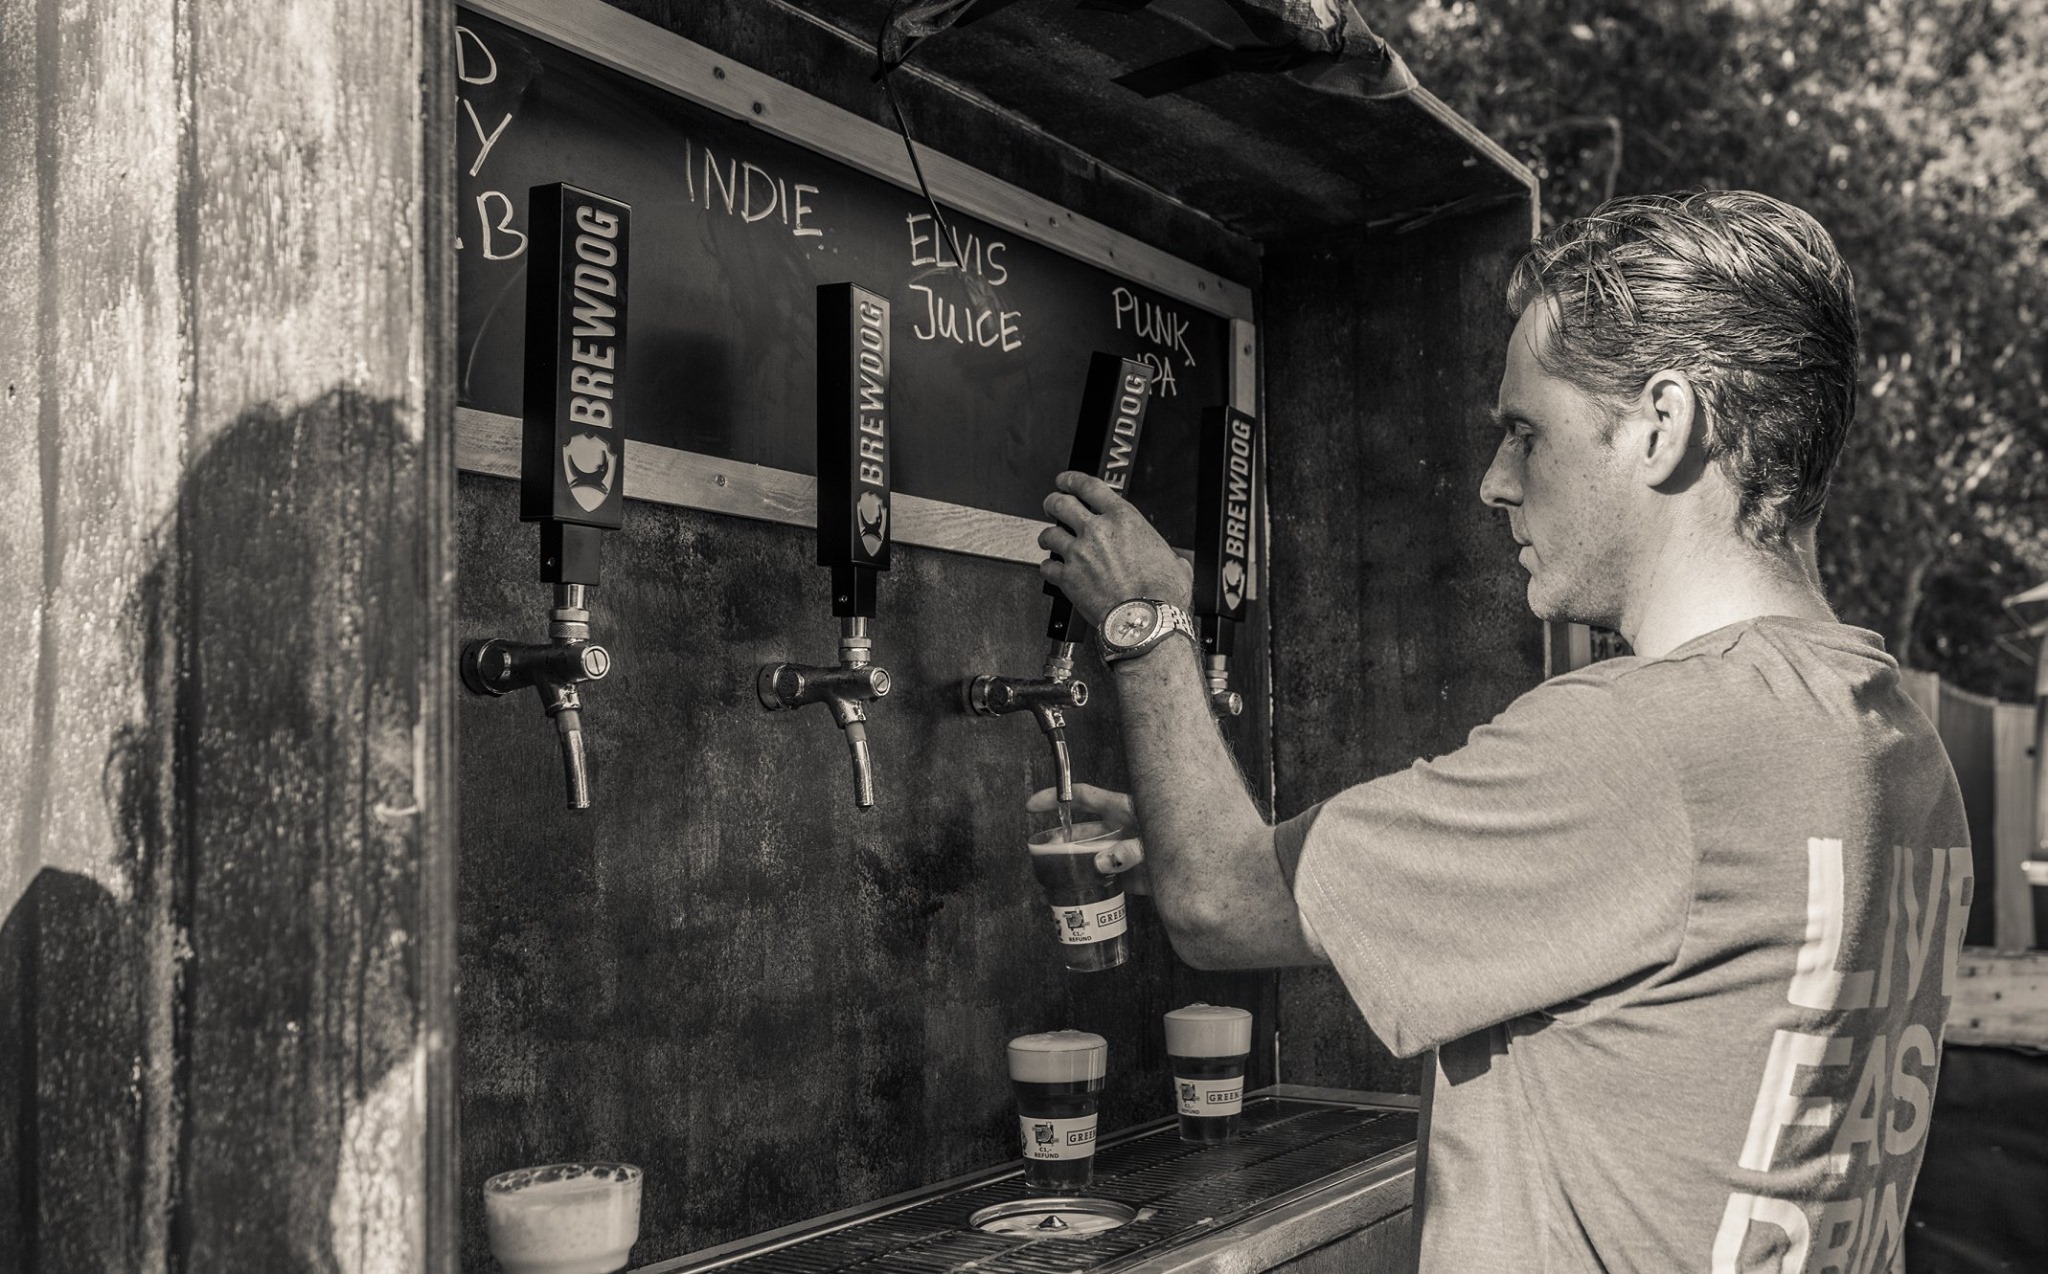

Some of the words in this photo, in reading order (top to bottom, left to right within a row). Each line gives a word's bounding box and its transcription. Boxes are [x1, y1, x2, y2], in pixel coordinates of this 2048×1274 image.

[686, 138, 823, 236] INDIE
[906, 213, 1008, 286] ELVIS
[569, 204, 619, 429] BREWDOG
[909, 284, 1022, 352] JUICE
[1112, 287, 1196, 367] PUNK
[859, 300, 885, 487] BREWDOG
[1136, 352, 1177, 398] PA
[1104, 371, 1147, 497] EWDOG
[1225, 418, 1252, 559] BREWDOG
[1738, 1022, 1946, 1176] FAS
